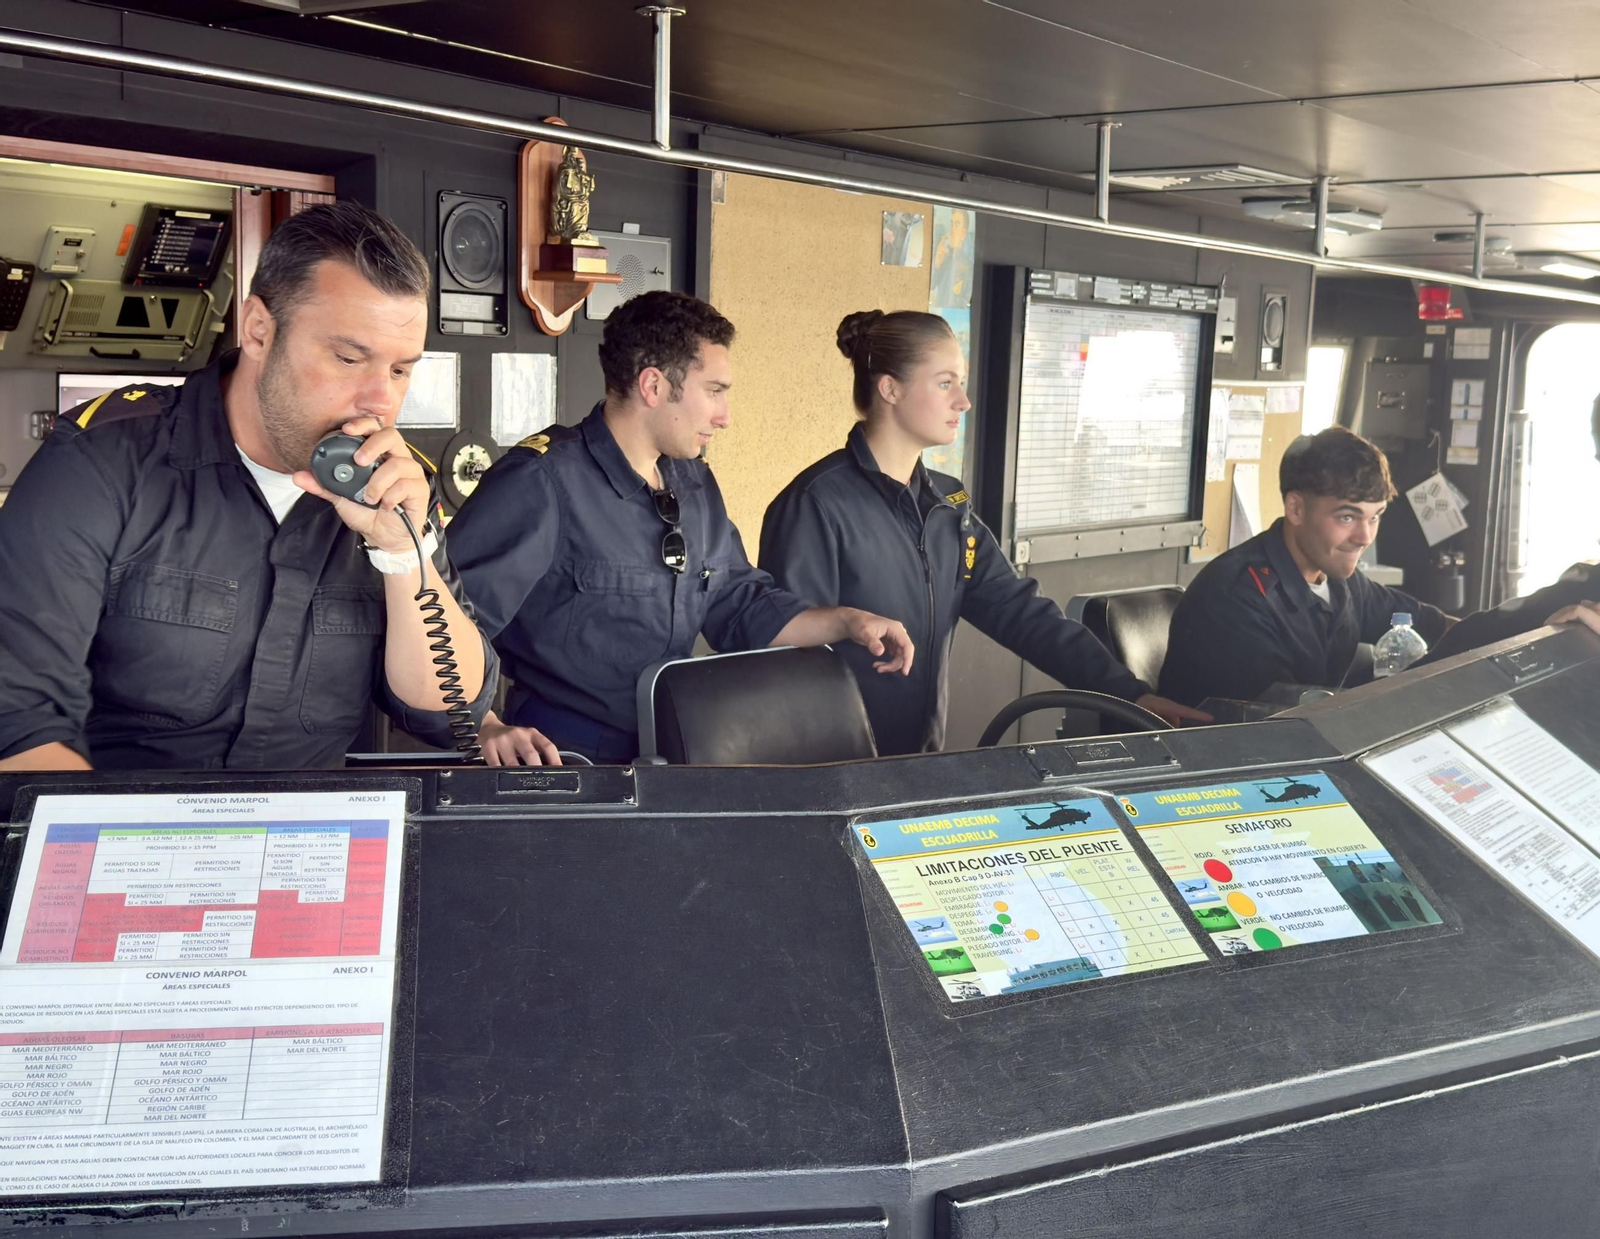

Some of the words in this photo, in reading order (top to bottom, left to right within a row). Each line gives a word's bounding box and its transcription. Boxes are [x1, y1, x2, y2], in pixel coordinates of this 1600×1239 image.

[1154, 792, 1199, 805] UNAEMB
[1201, 788, 1241, 801] DECIMA
[1175, 802, 1242, 816] ESCUADRILLA
[899, 820, 952, 834] UNAEMB
[953, 814, 999, 828] DECIMA
[1225, 818, 1292, 834] SEMAFORO
[921, 829, 998, 848] ESCUADRILLA
[1194, 851, 1215, 859] ROJO:
[1232, 846, 1252, 854] PUEDE
[1254, 844, 1273, 852] CAER
[1281, 840, 1306, 849] RUMBO
[1228, 856, 1263, 866] ATENCION
[1282, 849, 1326, 861] MOVIMIENTO
[1336, 844, 1367, 855] CUBIERTA
[916, 853, 1027, 876] LIMITACIONES
[1030, 850, 1061, 863] DEL
[1062, 840, 1123, 858] PUENTE
[928, 877, 954, 886] Anexo
[962, 874, 978, 884] Cap
[986, 869, 1015, 879] D-AV-31
[1218, 883, 1246, 892] AMBAR:
[1248, 880, 1259, 888] NO
[1260, 875, 1290, 887] CAMBIOS
[936, 885, 979, 896] MOVIMIENTO
[940, 893, 982, 904] DESPLEGADO
[1265, 887, 1303, 897] VELOCIDAD
[1240, 917, 1267, 926] VERDE:
[1282, 909, 1313, 920] CAMBIOS
[1313, 907, 1323, 915] DE
[1285, 920, 1324, 932] VELOCIDAD
[968, 942, 998, 951] PLEGADO
[146, 971, 200, 979] CONVENIO
[203, 970, 247, 978] MARPOL
[37, 1098, 82, 1106] ANTÁRTICO
[173, 1094, 217, 1102] ANTÁRTICO
